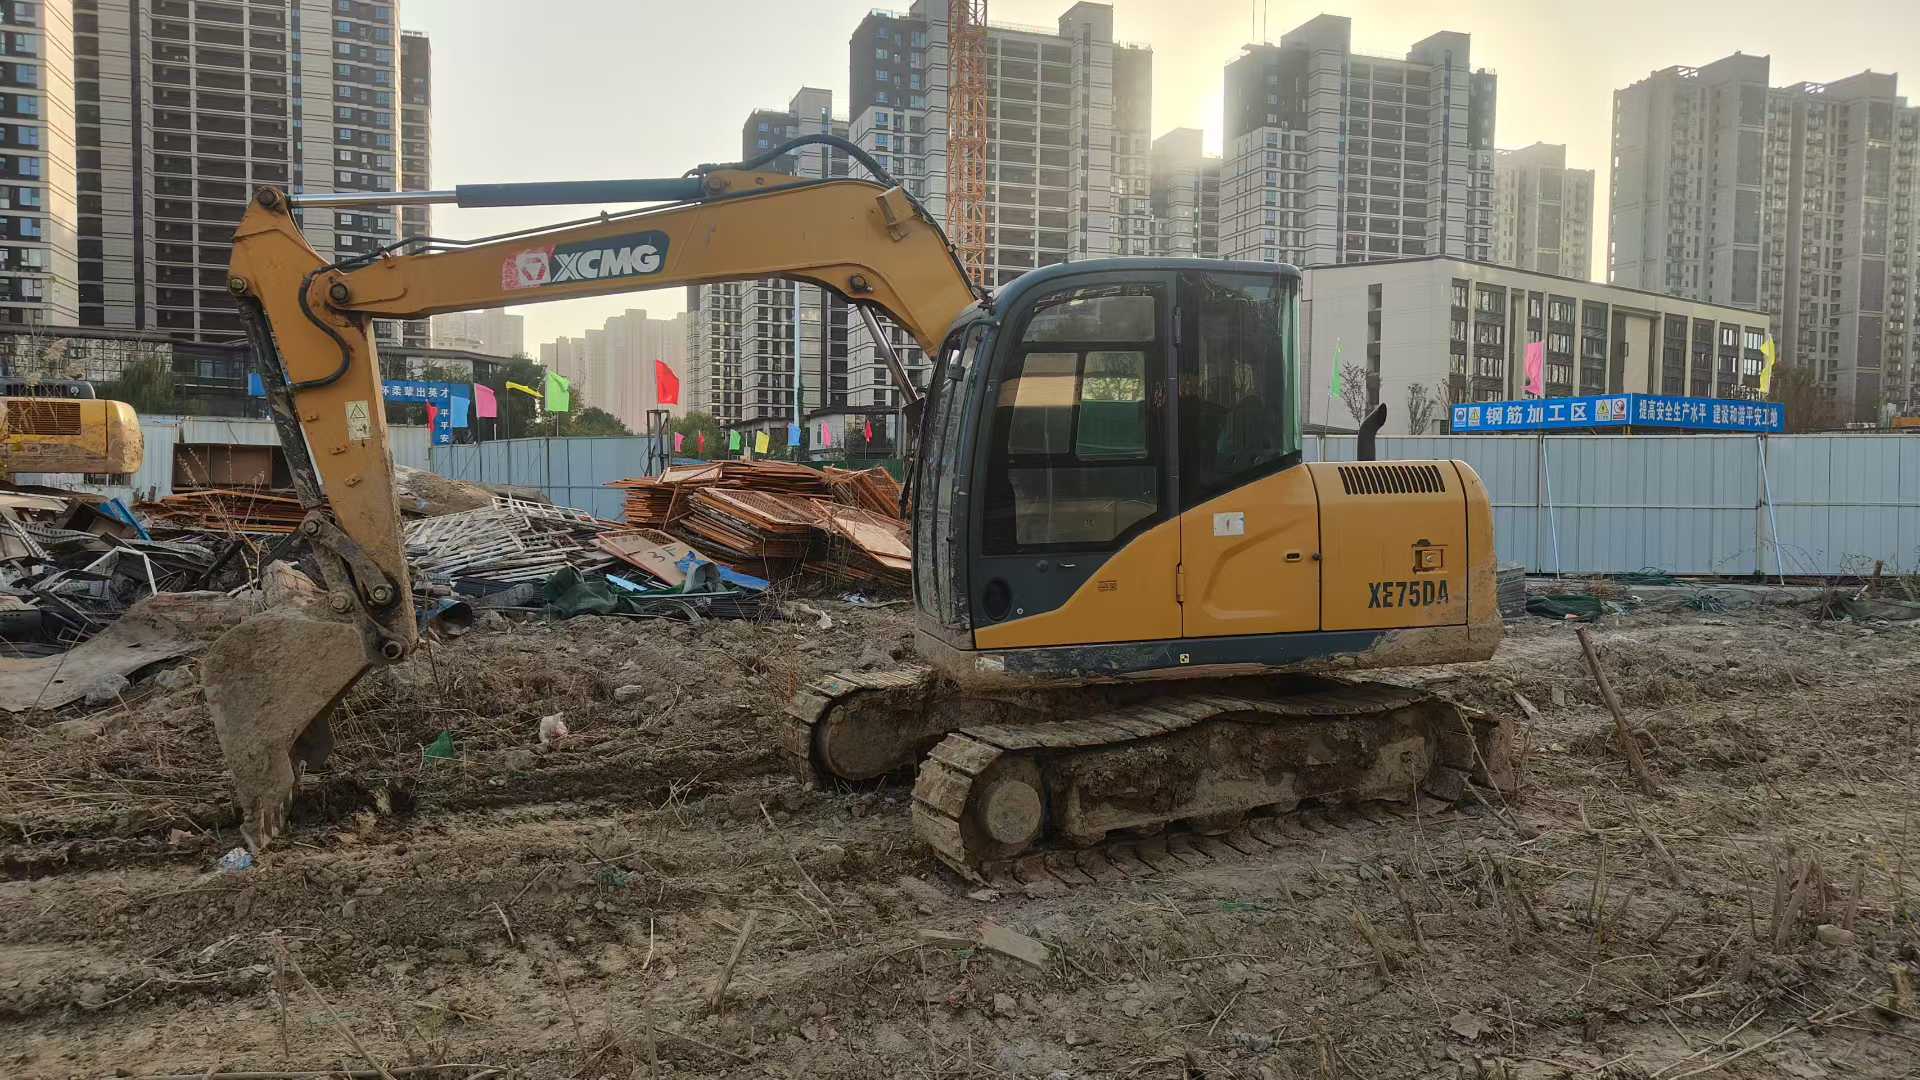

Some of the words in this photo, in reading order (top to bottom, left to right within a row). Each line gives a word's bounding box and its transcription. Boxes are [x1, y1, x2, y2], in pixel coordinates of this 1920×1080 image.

[551, 244, 660, 282] XCMG
[1486, 402, 1588, 425] 钢筋加工区
[1639, 400, 1707, 423] 提高安全生产水平
[1368, 580, 1448, 608] XE75DA
